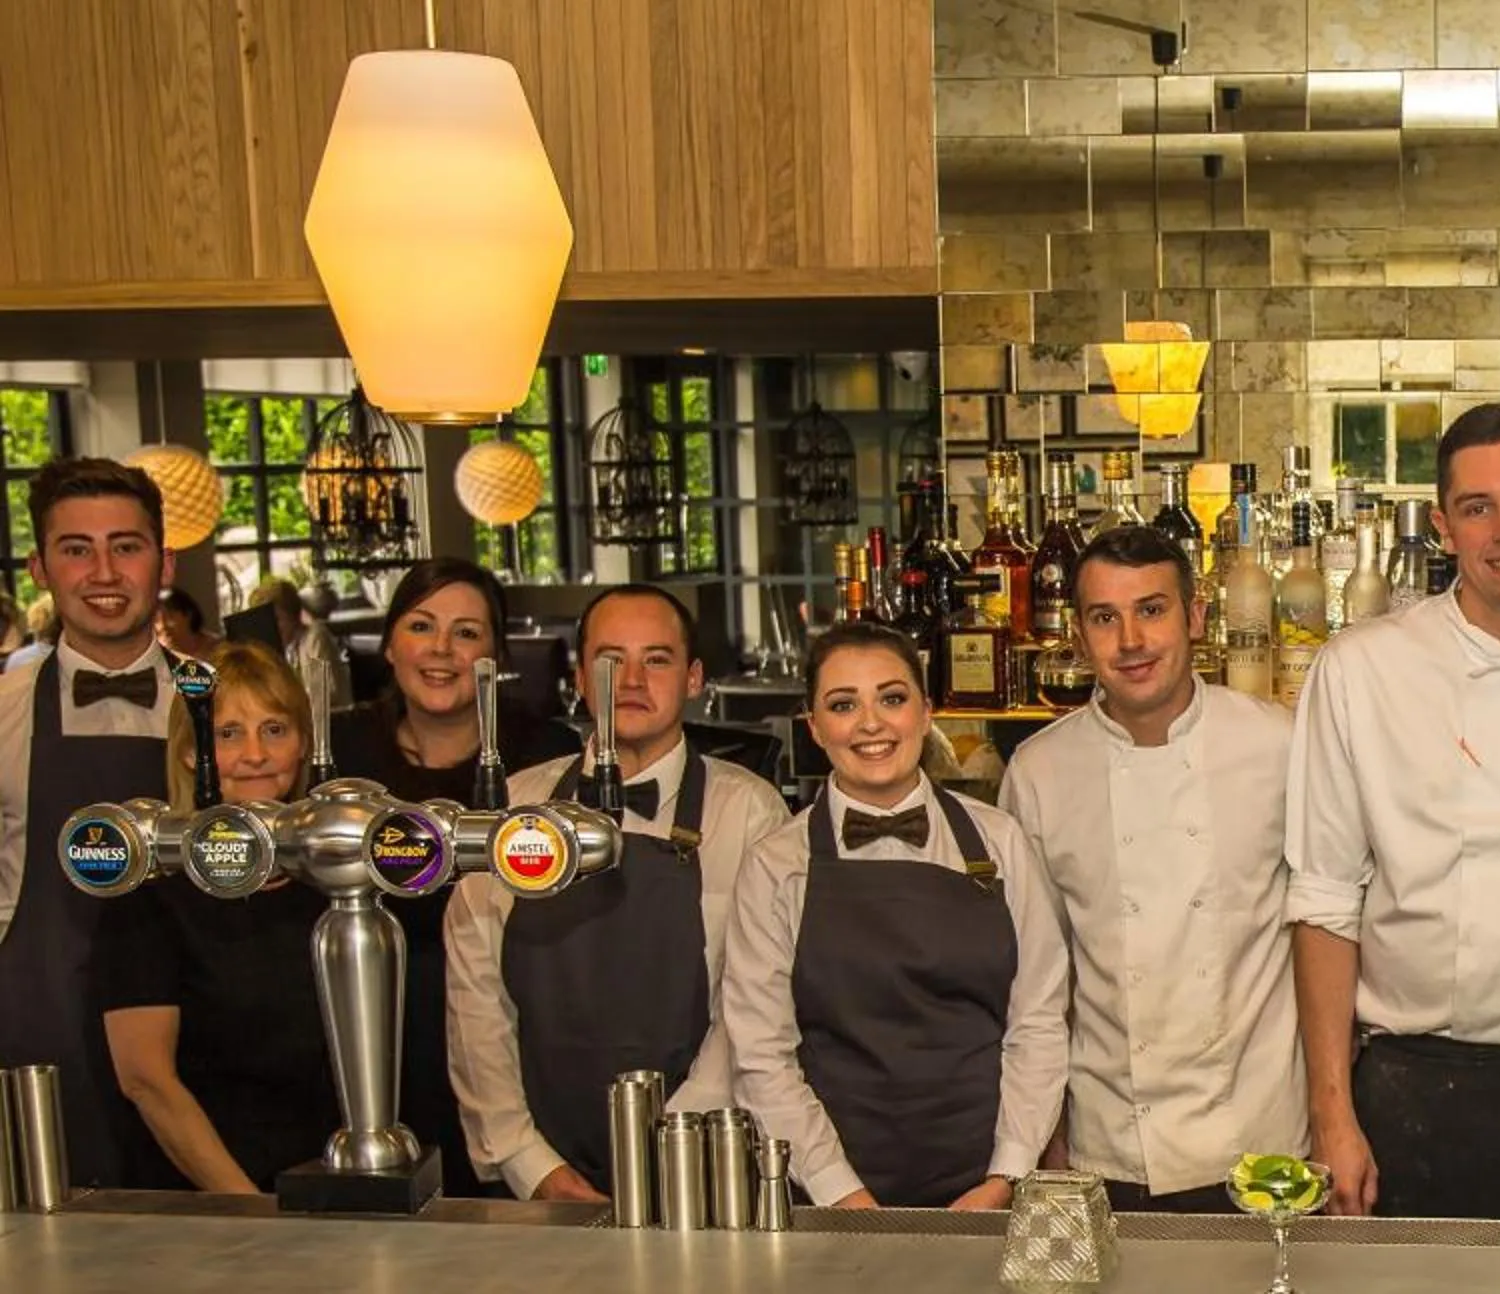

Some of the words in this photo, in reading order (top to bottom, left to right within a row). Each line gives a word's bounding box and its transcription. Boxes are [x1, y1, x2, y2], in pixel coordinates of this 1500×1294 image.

[69, 845, 127, 861] GUINNESS
[200, 843, 248, 853] CLOUDY
[508, 843, 550, 854] AMSTEL
[204, 853, 248, 863] APPLE
